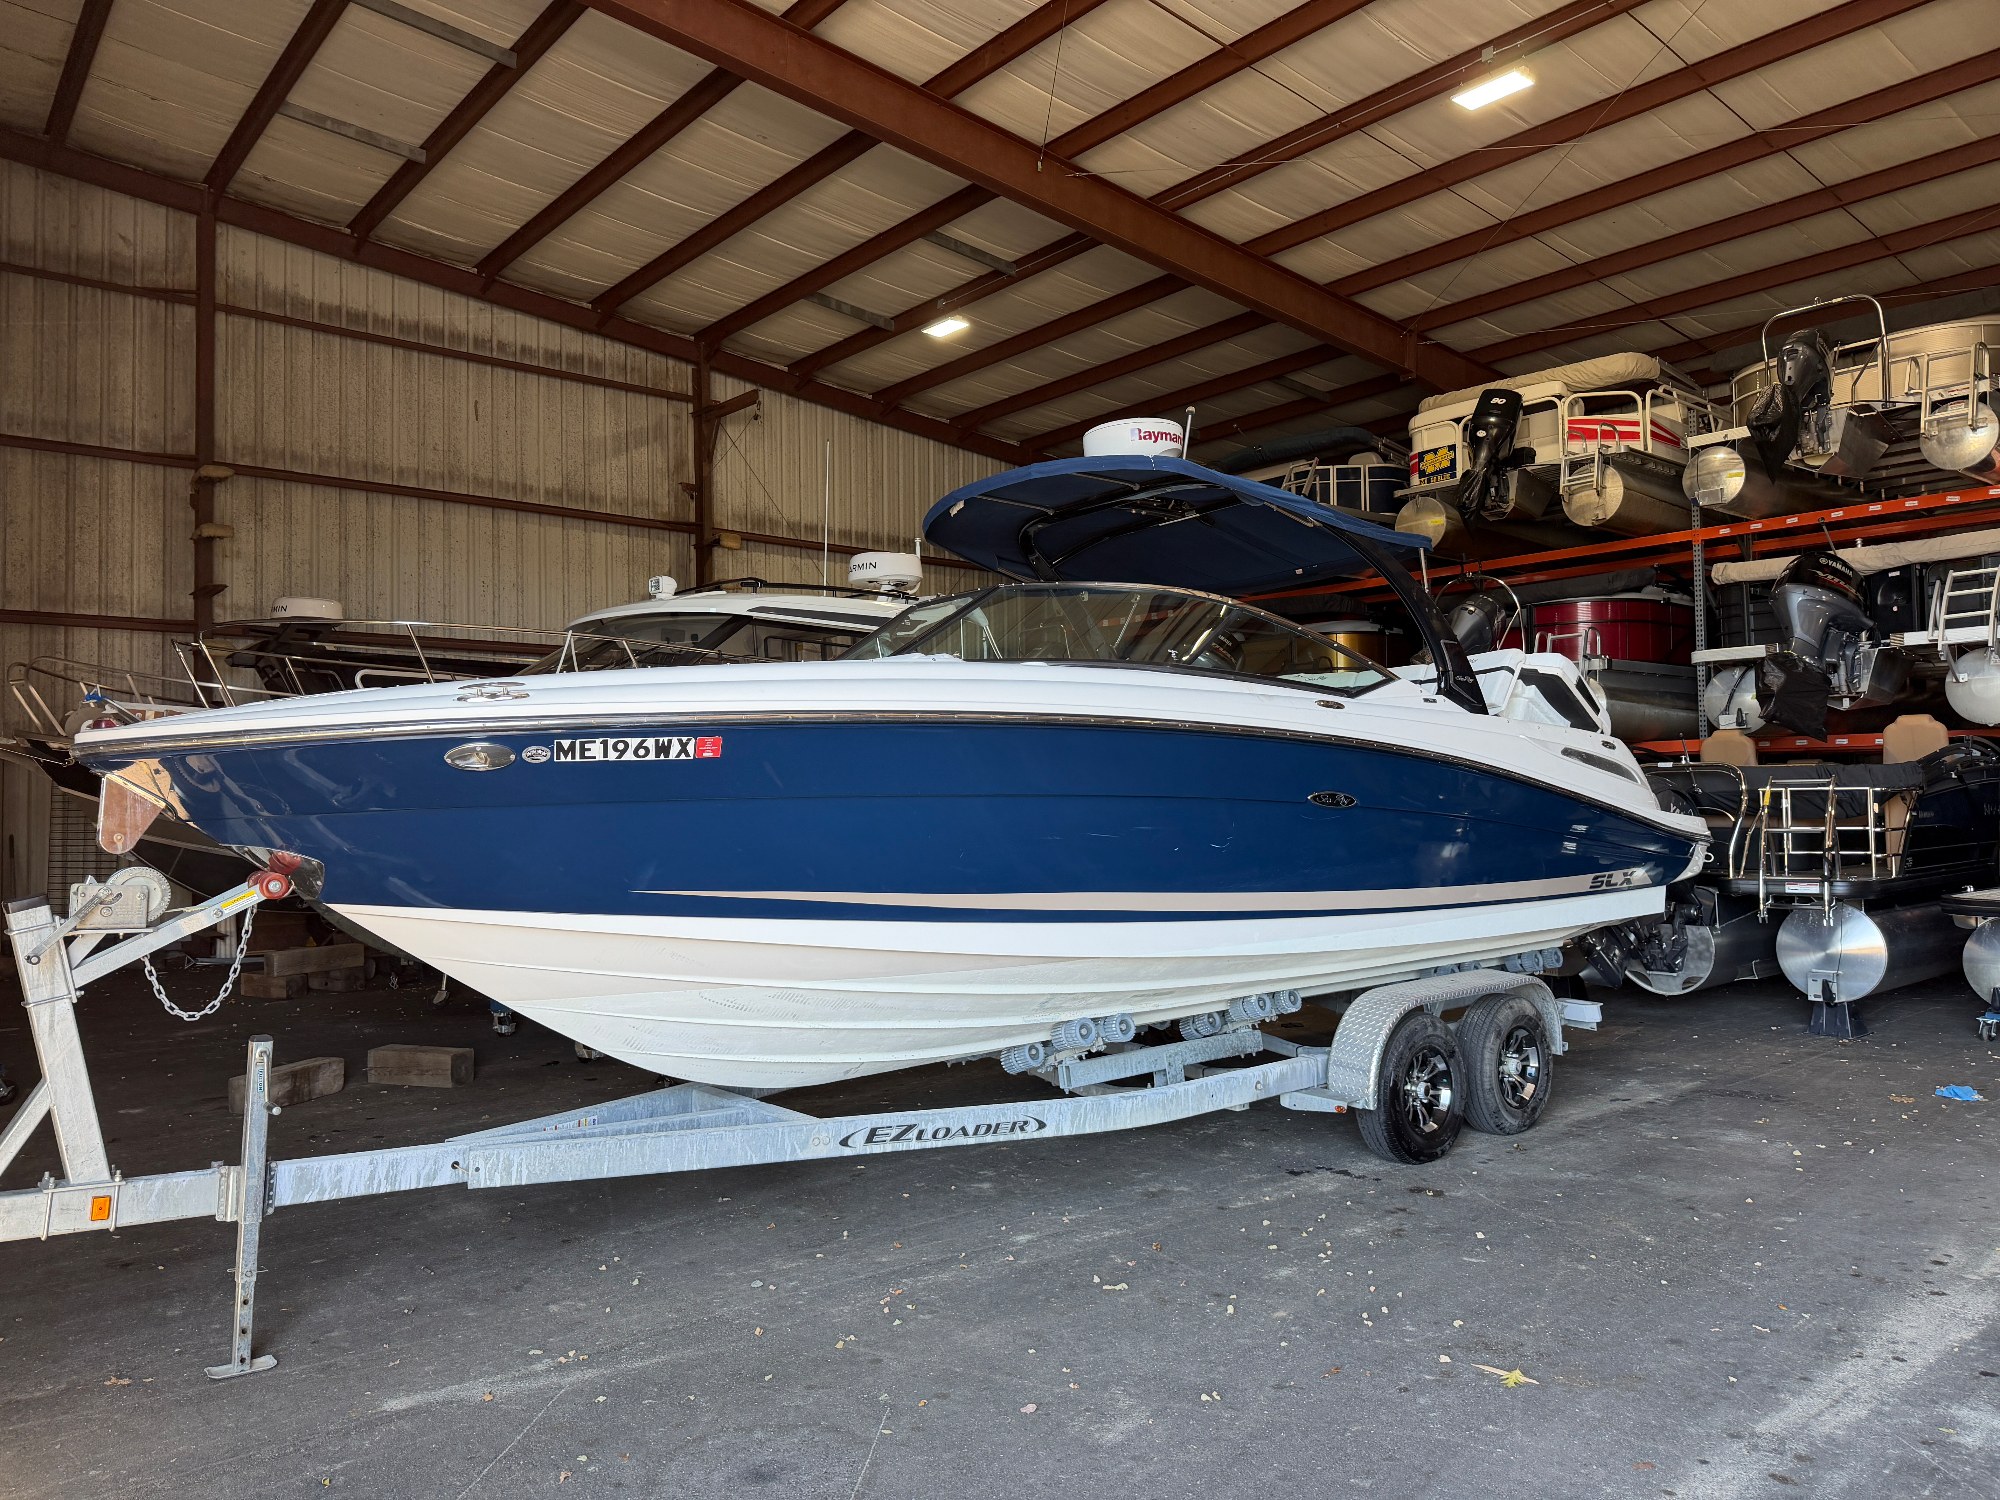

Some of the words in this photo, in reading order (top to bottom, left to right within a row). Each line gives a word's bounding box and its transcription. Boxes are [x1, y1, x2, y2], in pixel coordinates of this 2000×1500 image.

[848, 561, 877, 575] ARMIN
[1828, 560, 1853, 578] YAMAHA
[1589, 870, 1637, 890] SLX
